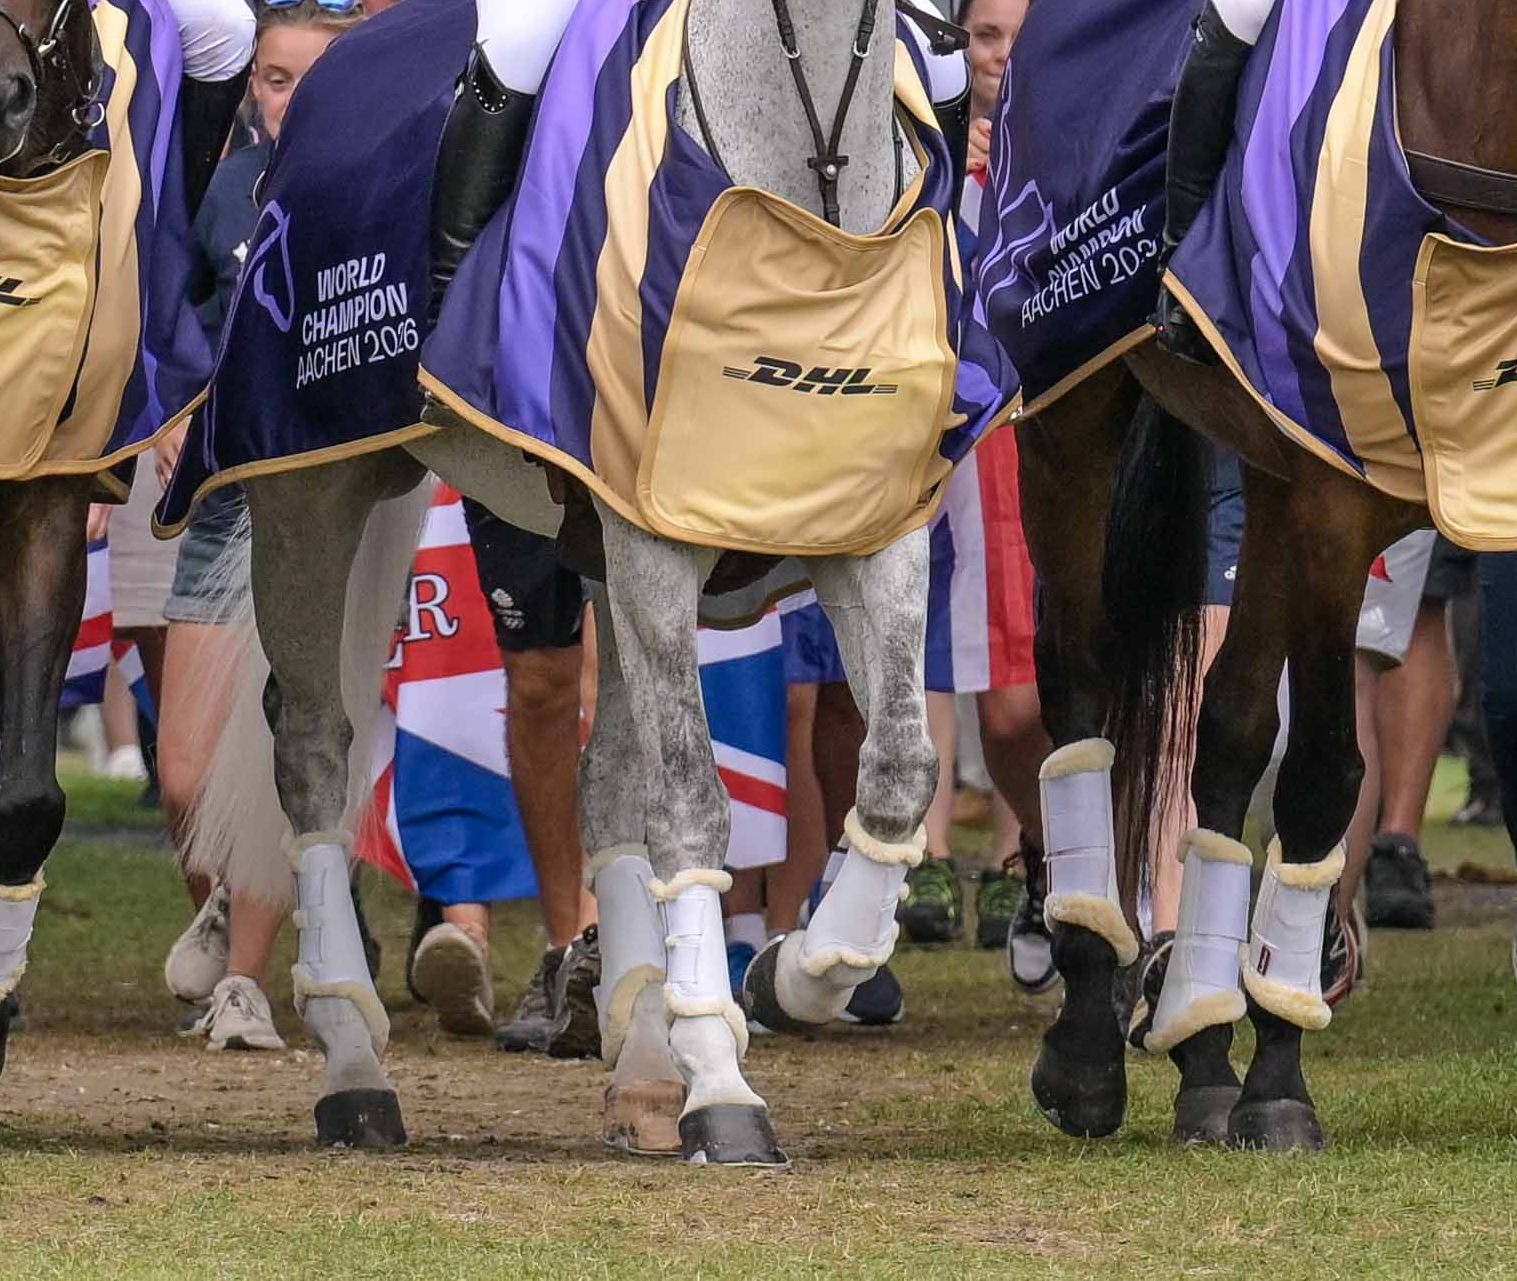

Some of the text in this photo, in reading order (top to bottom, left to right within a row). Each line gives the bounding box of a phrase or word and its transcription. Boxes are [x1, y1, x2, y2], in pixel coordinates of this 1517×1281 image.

[317, 253, 386, 302] WORLD
[1021, 259, 1101, 328] AACHEN
[302, 283, 408, 346] CHAMPION
[296, 318, 419, 389] AACHEN 2026
[747, 356, 876, 395] DHL
